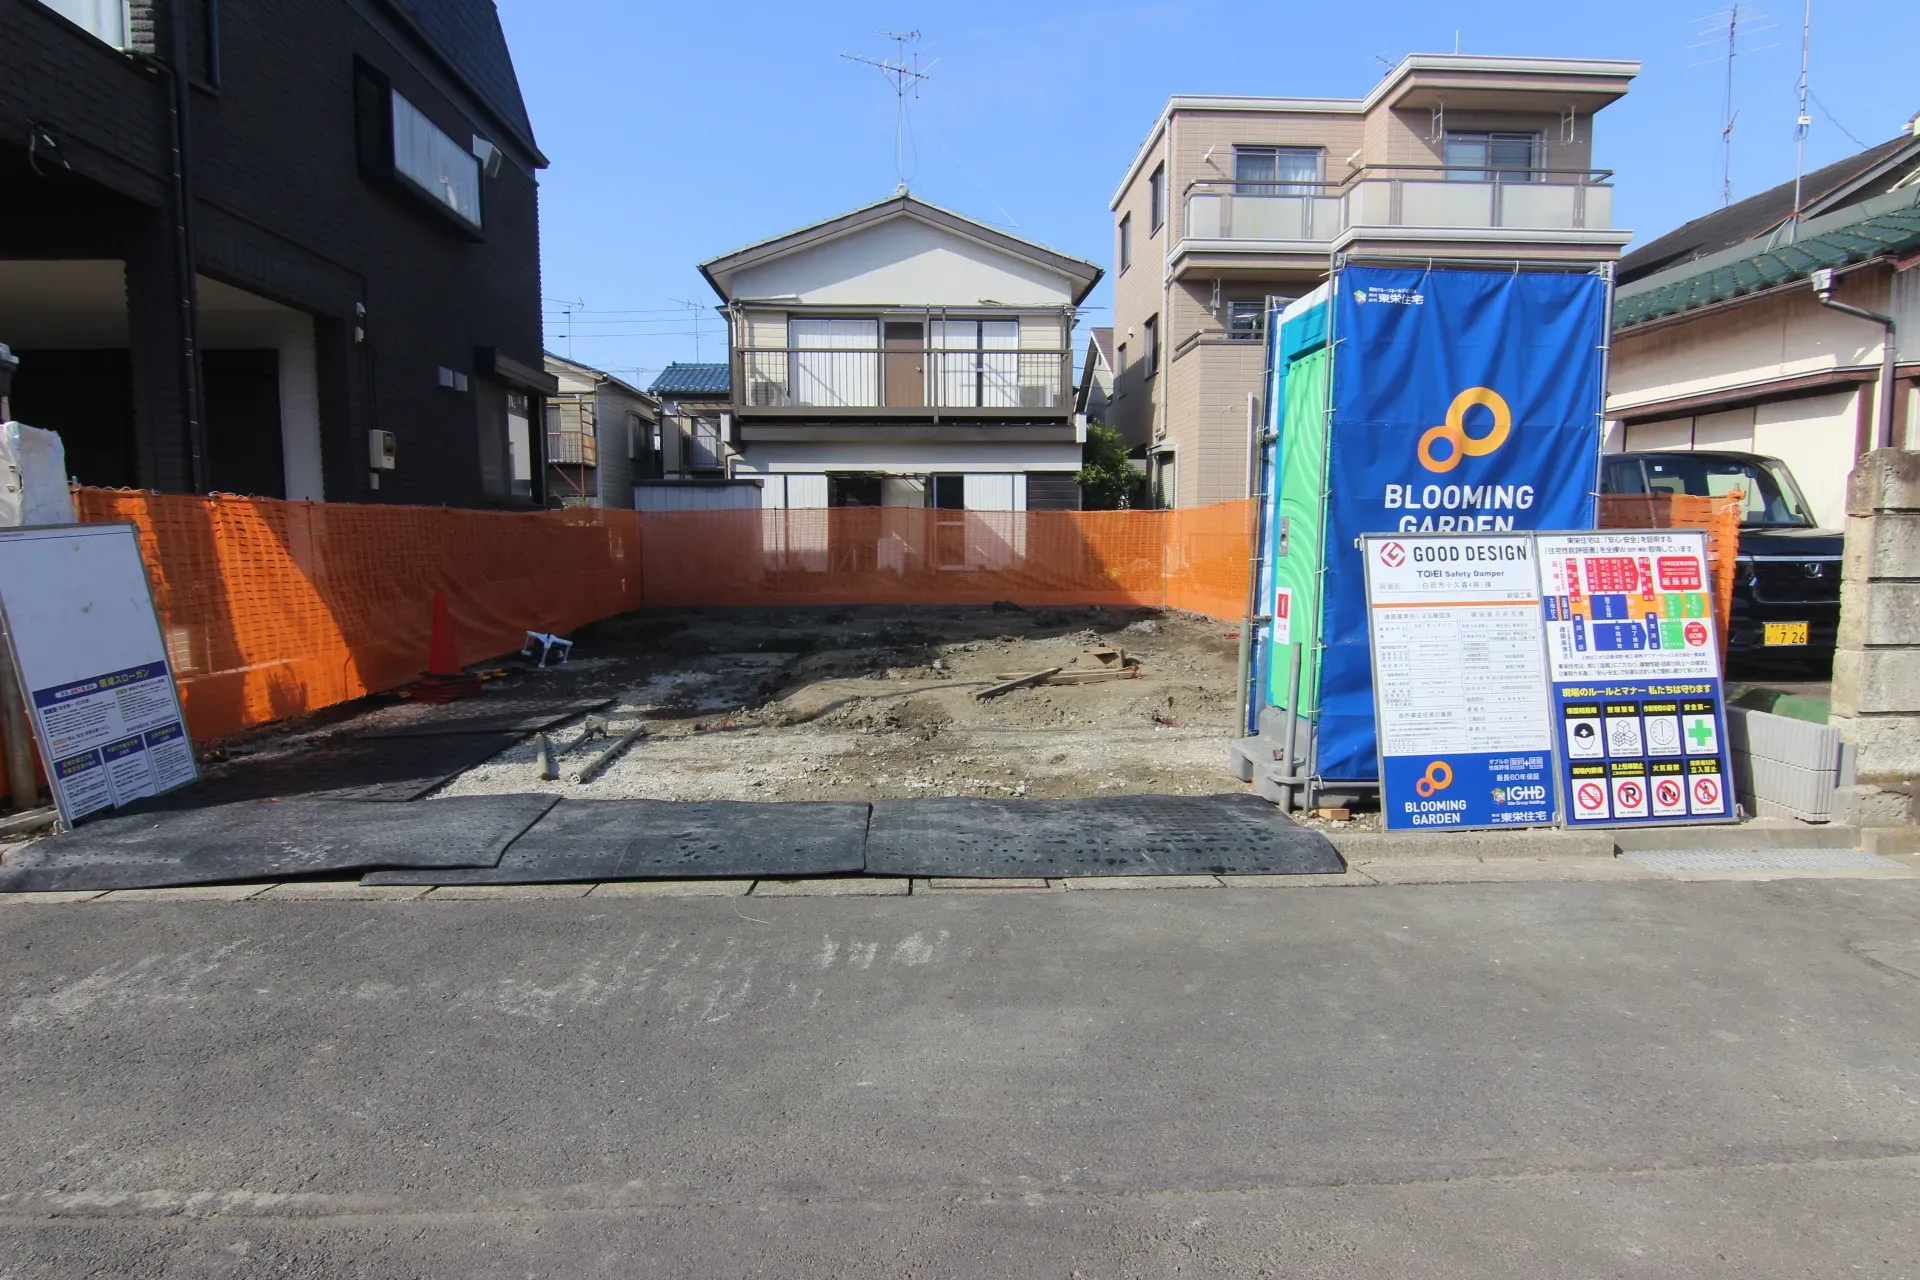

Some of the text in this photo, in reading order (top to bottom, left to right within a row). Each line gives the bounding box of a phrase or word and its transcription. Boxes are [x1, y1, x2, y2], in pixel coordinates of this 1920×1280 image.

[1378, 294, 1424, 304] 東栄住宅
[1385, 485, 1534, 509] BLOOMING
[1399, 515, 1514, 533] GARDEN
[1413, 545, 1527, 562] GOOD DESIGN
[1417, 569, 1505, 578] TOEI Safety Damper
[1662, 577, 1699, 585] 延長保証
[1631, 625, 1639, 648] 完了検査
[99, 670, 149, 688] 現場スローガン
[1562, 684, 1711, 697] 現場のルールとマナー 私たちは守ります
[1496, 773, 1540, 781] 最長60年保証
[1506, 786, 1546, 800] IGHD
[1405, 800, 1467, 813] BLOOMING
[1412, 812, 1461, 825] GARDEN
[1501, 811, 1547, 822] 東栄住宅
